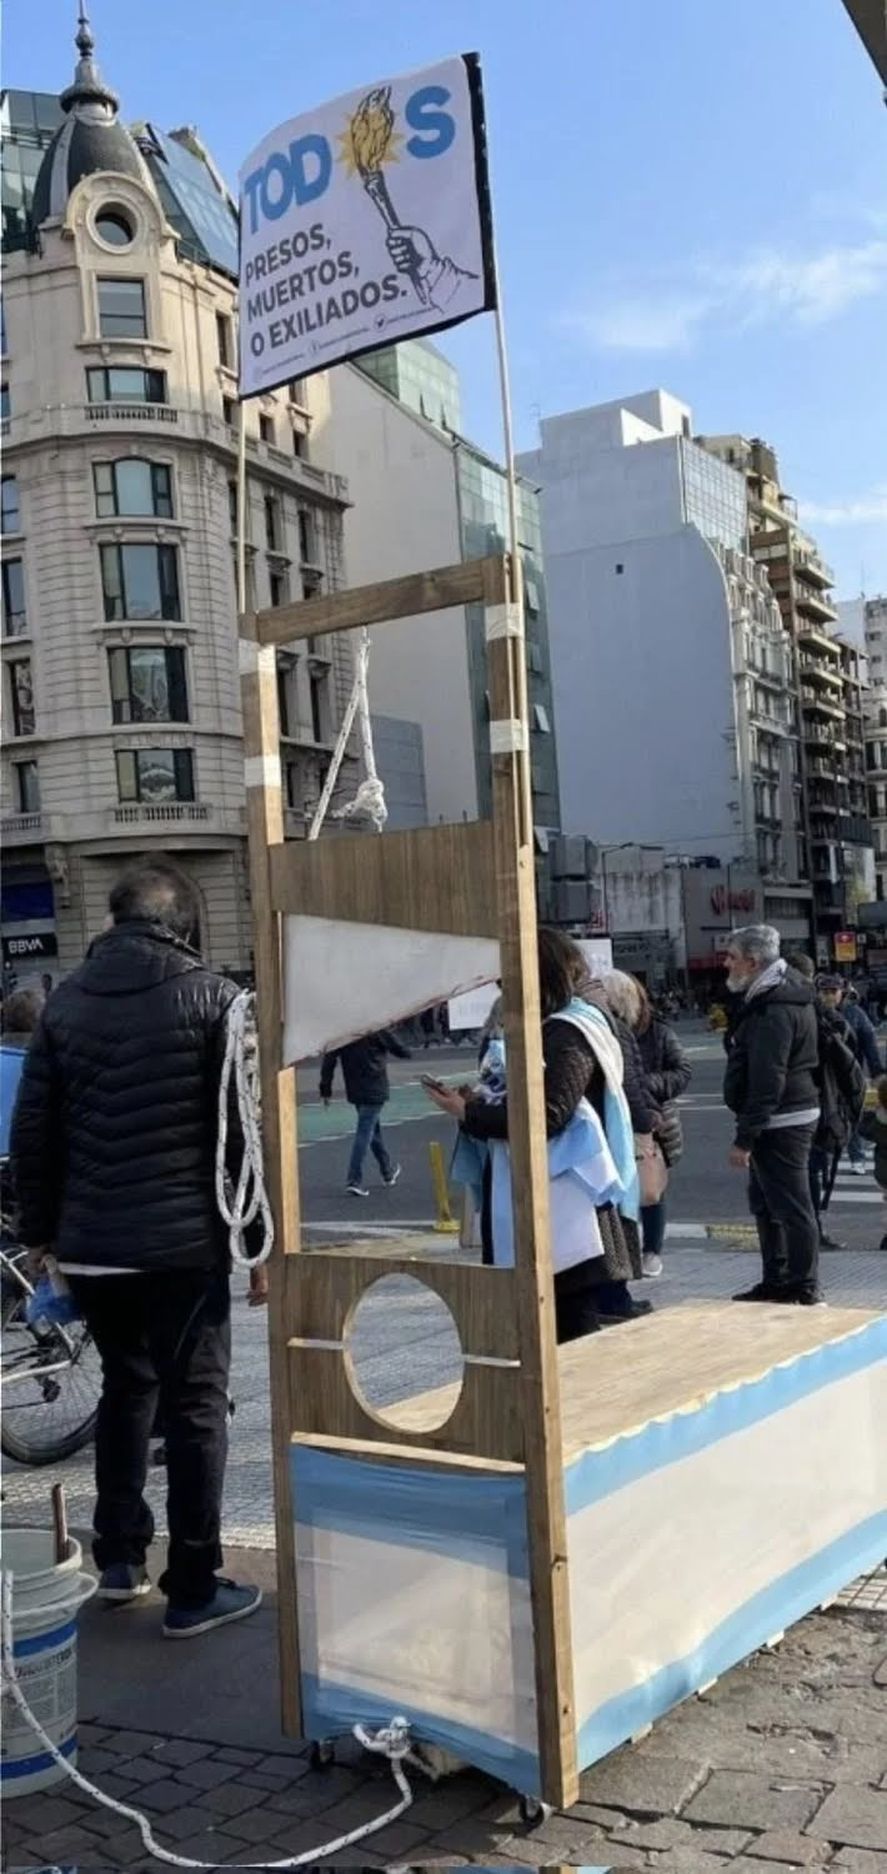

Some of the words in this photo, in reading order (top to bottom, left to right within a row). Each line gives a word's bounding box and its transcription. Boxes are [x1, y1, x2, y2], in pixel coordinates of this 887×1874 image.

[246, 223, 332, 284] PRESOS,
[247, 250, 361, 323] MUERTOS,
[251, 331, 265, 357] O
[269, 275, 407, 348] EXILIADOS.
[9, 938, 44, 954] BBVA
